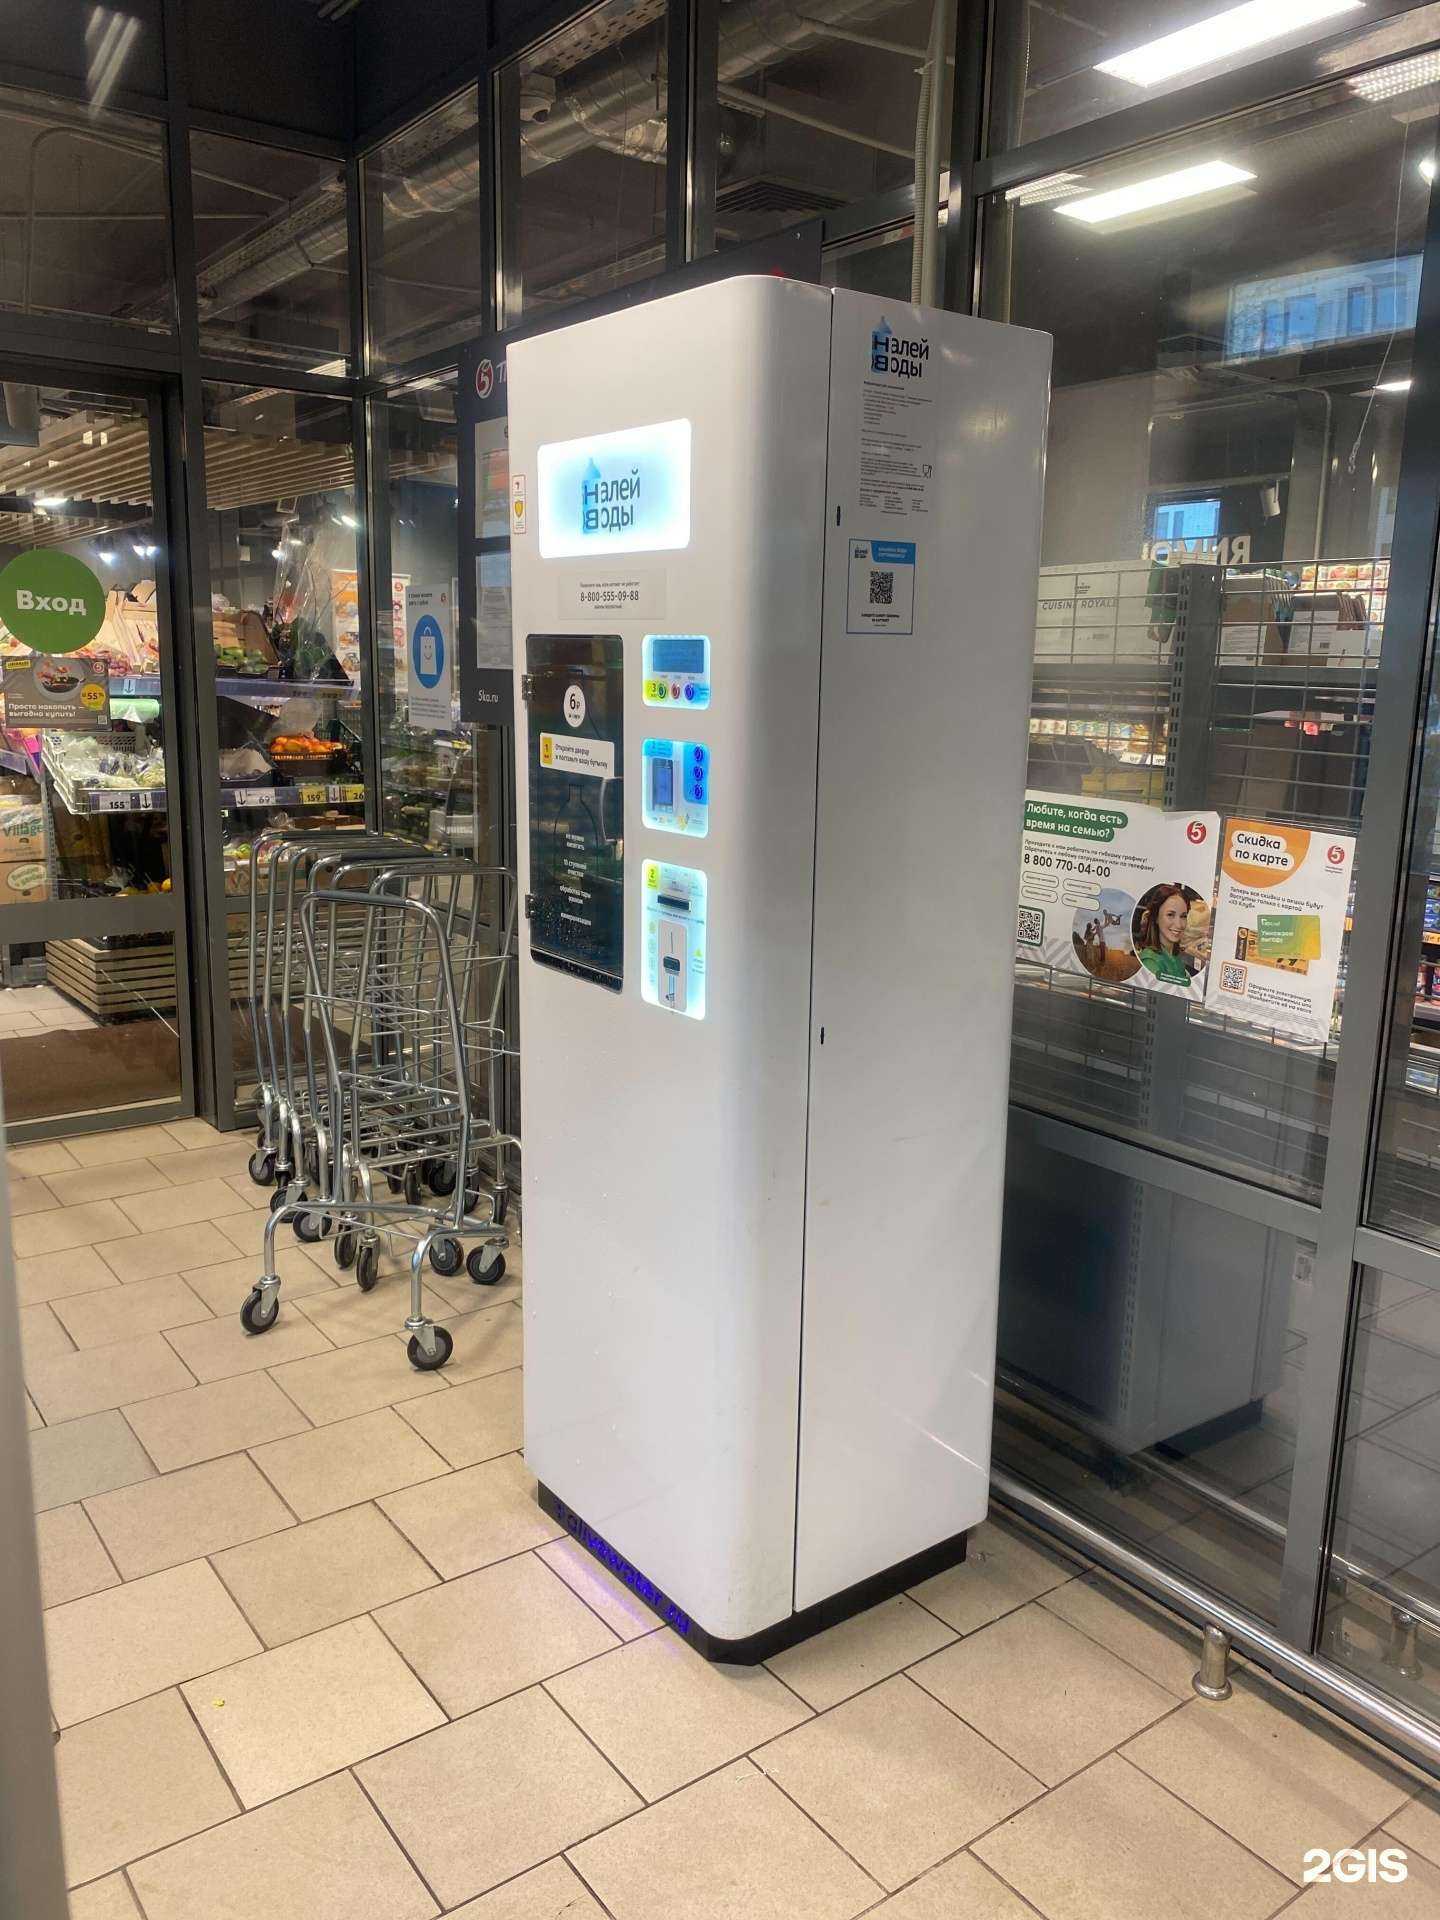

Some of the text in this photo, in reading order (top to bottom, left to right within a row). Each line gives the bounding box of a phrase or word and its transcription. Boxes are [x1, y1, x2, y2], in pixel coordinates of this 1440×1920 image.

[873, 335, 929, 361] Налей
[584, 468, 641, 505] Налей
[16, 589, 87, 616] Вход
[580, 590, 639, 602] 8-800-555-09-88
[8, 703, 37, 711] Просто
[570, 693, 576, 710] 6
[109, 801, 125, 809] 155
[1027, 803, 1123, 825] Любите, когда есть
[1026, 819, 1110, 839] время на семью?
[1236, 833, 1281, 849] Скидка
[1024, 853, 1111, 877] 8 800 770-04-00
[1235, 850, 1288, 866] по карте
